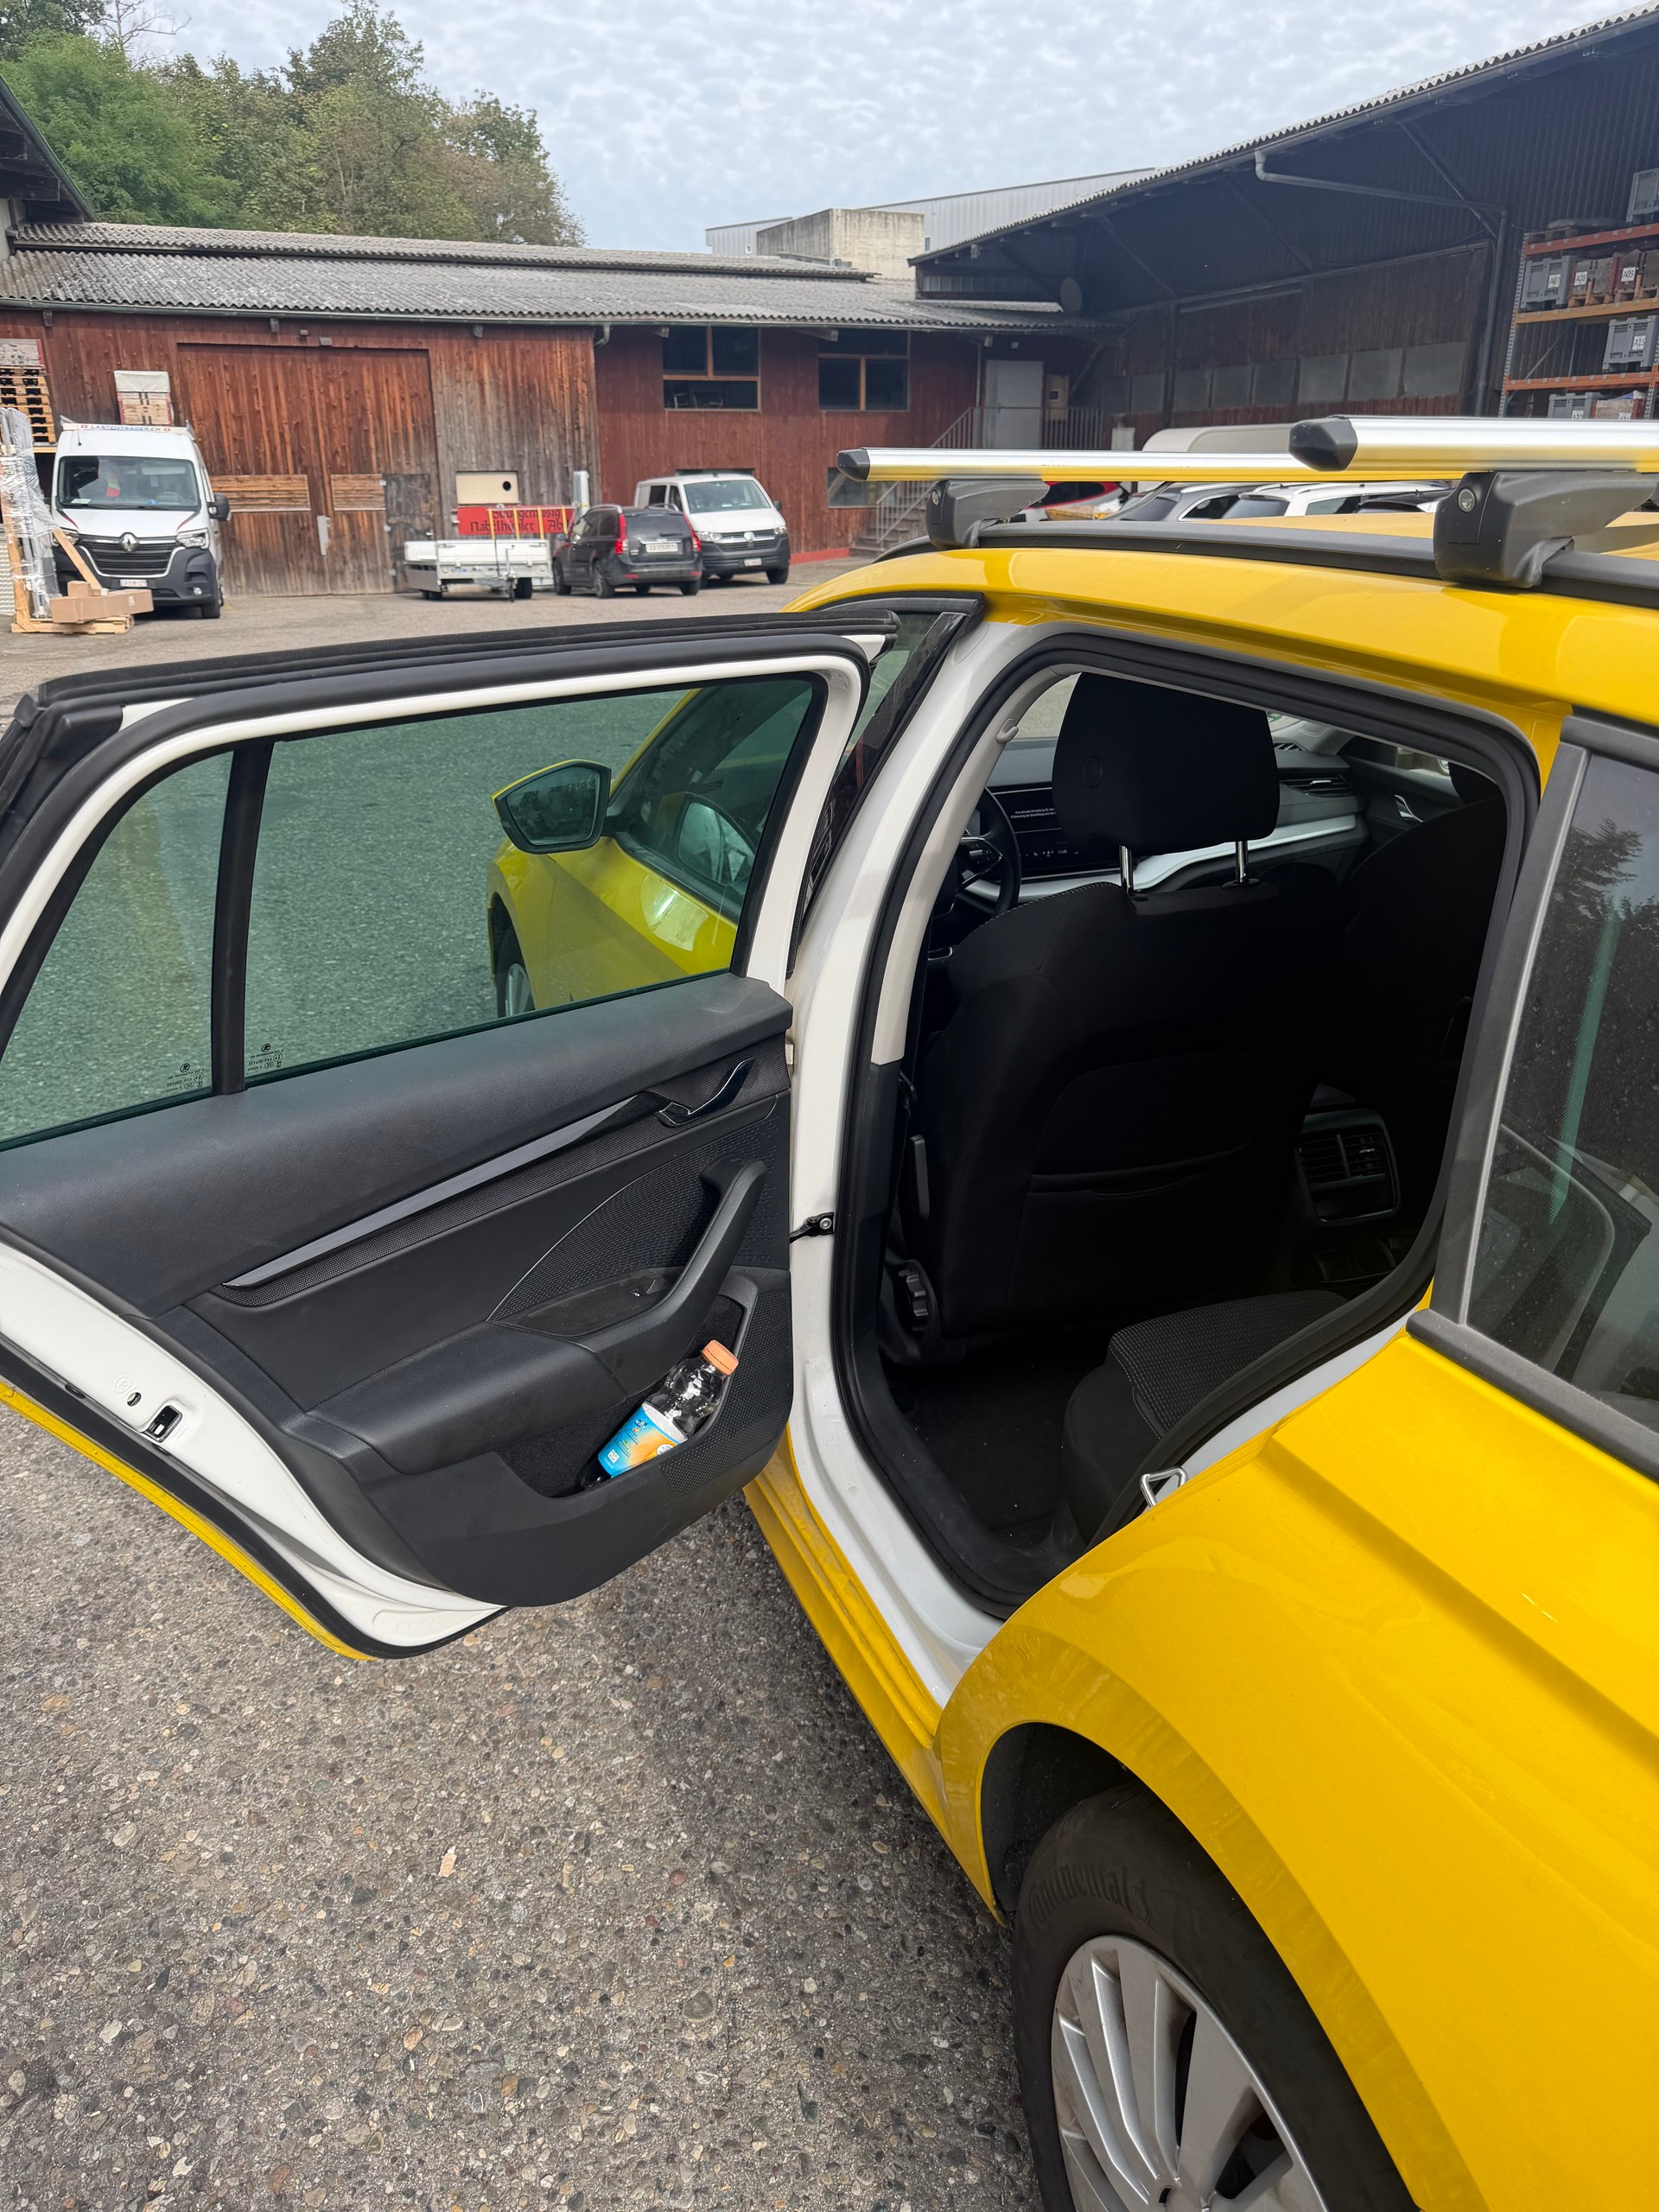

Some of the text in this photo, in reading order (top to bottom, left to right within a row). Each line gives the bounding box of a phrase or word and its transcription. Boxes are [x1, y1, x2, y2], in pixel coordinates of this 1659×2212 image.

[1623, 269, 1635, 278] A09
[1549, 276, 1560, 284] A07
[1633, 337, 1645, 346] A15
[1028, 1861, 1134, 1929] Continental
